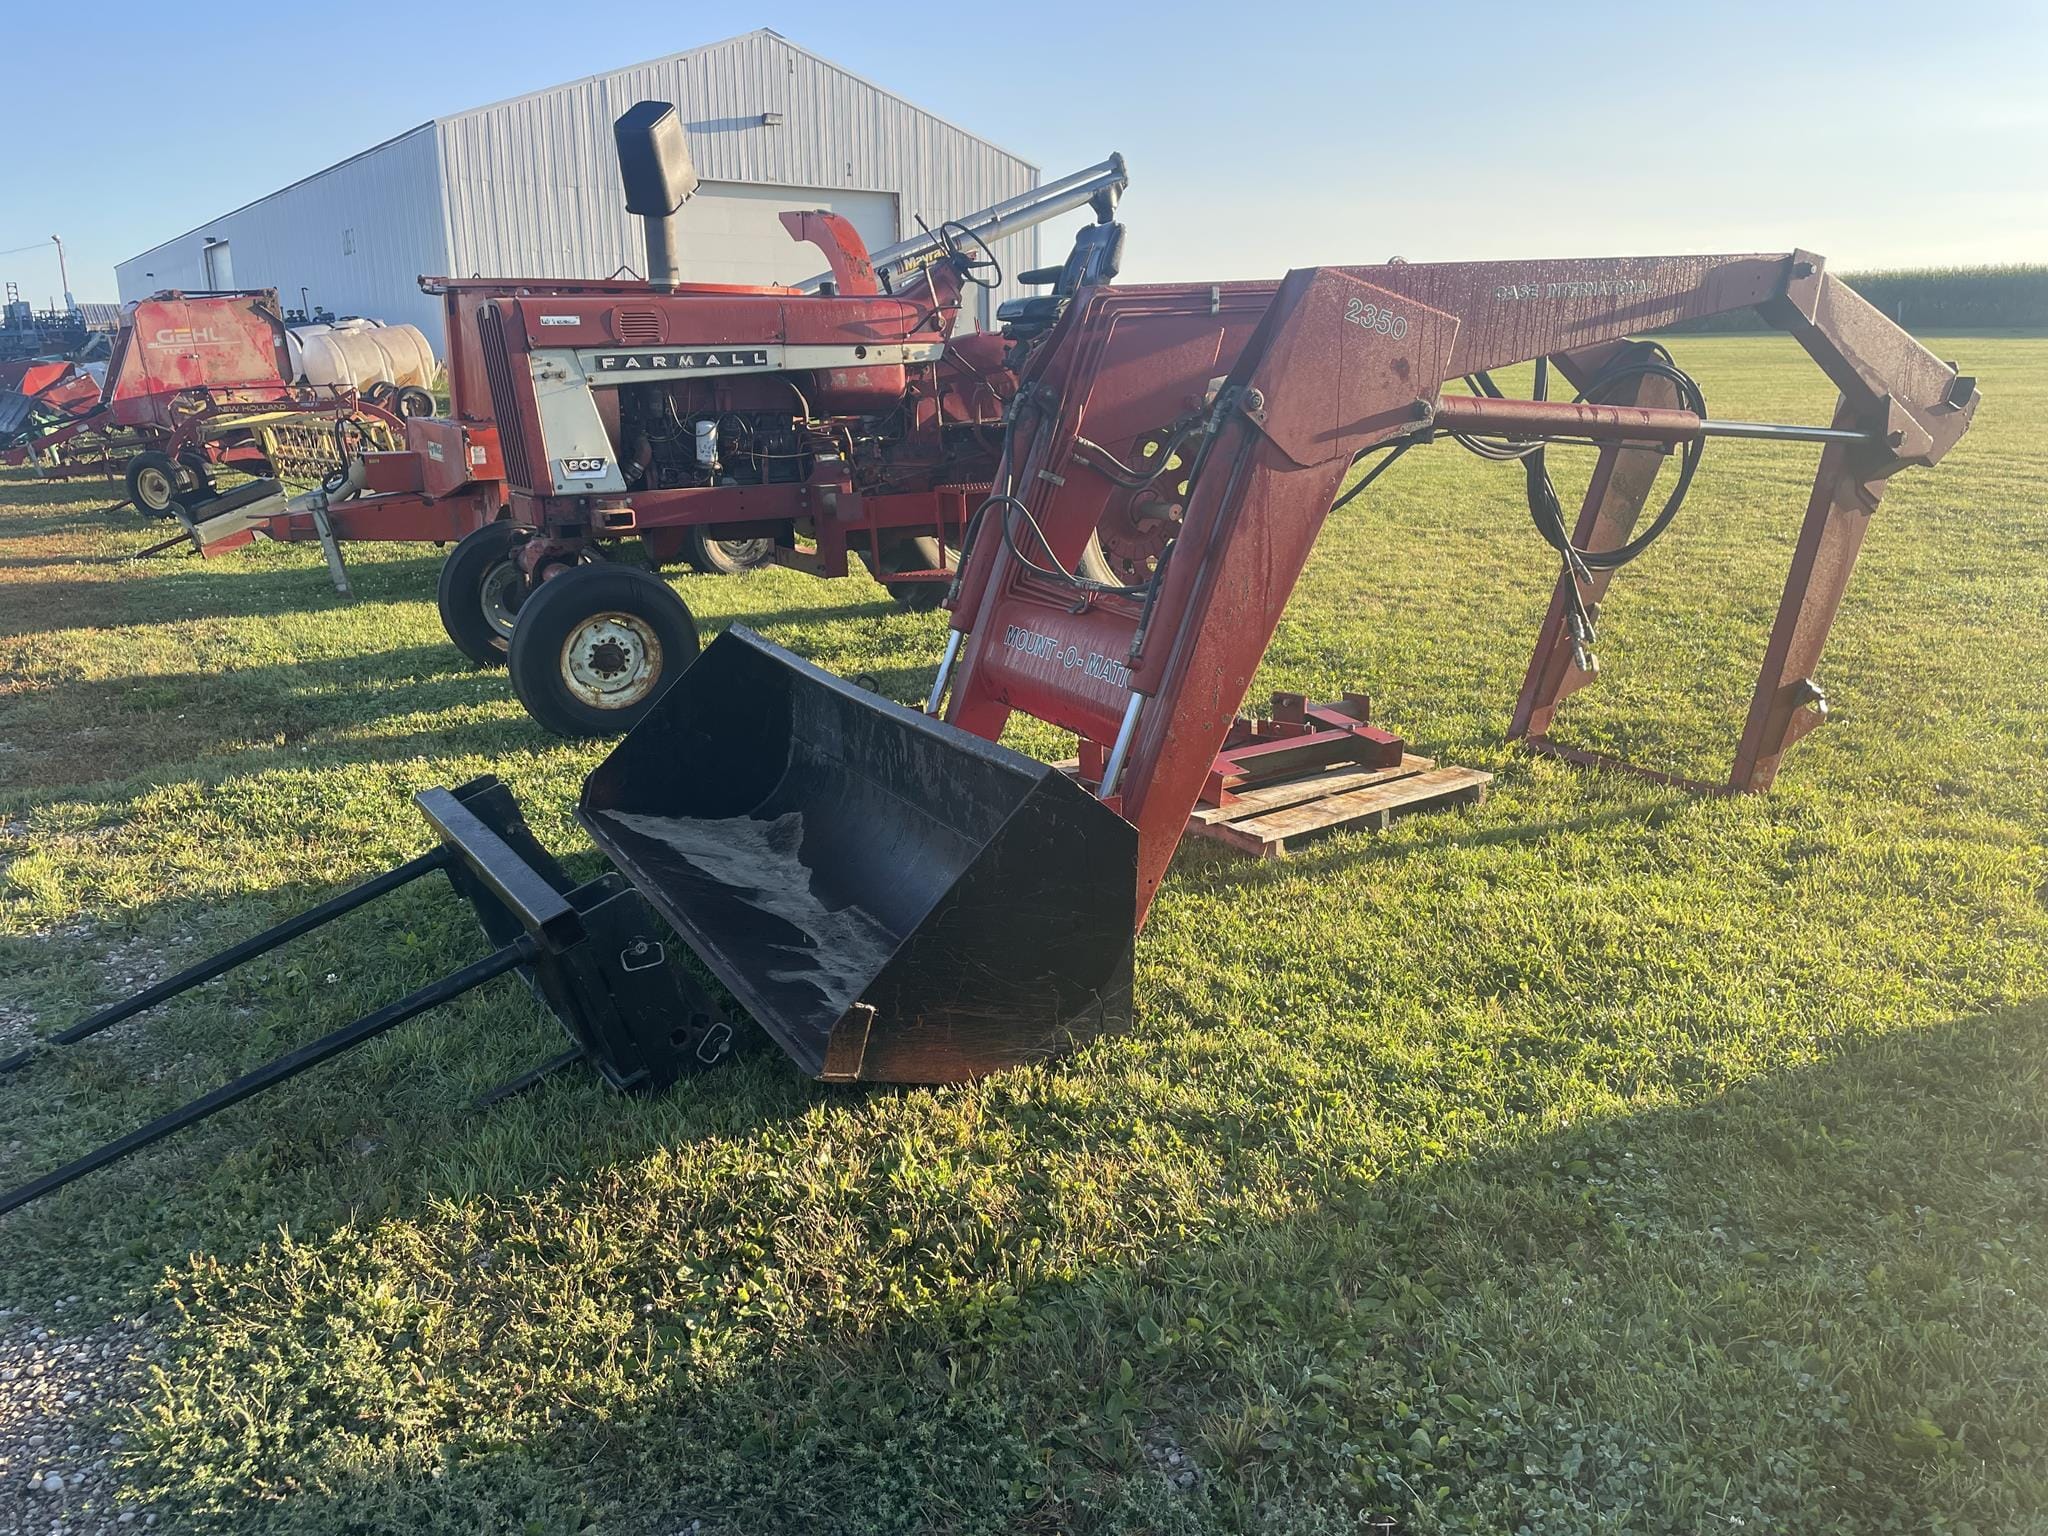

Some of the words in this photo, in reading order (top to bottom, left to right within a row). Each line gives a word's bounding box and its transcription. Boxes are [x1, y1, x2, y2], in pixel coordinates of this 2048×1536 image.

[903, 248, 946, 270] Mayra
[1495, 284, 1539, 300] CASE
[1344, 297, 1408, 340] 2350
[156, 327, 226, 343] GEHL
[602, 352, 766, 368] FARMALL
[217, 404, 239, 413] NEW
[242, 403, 287, 411] HOLLAND
[568, 460, 601, 470] 806
